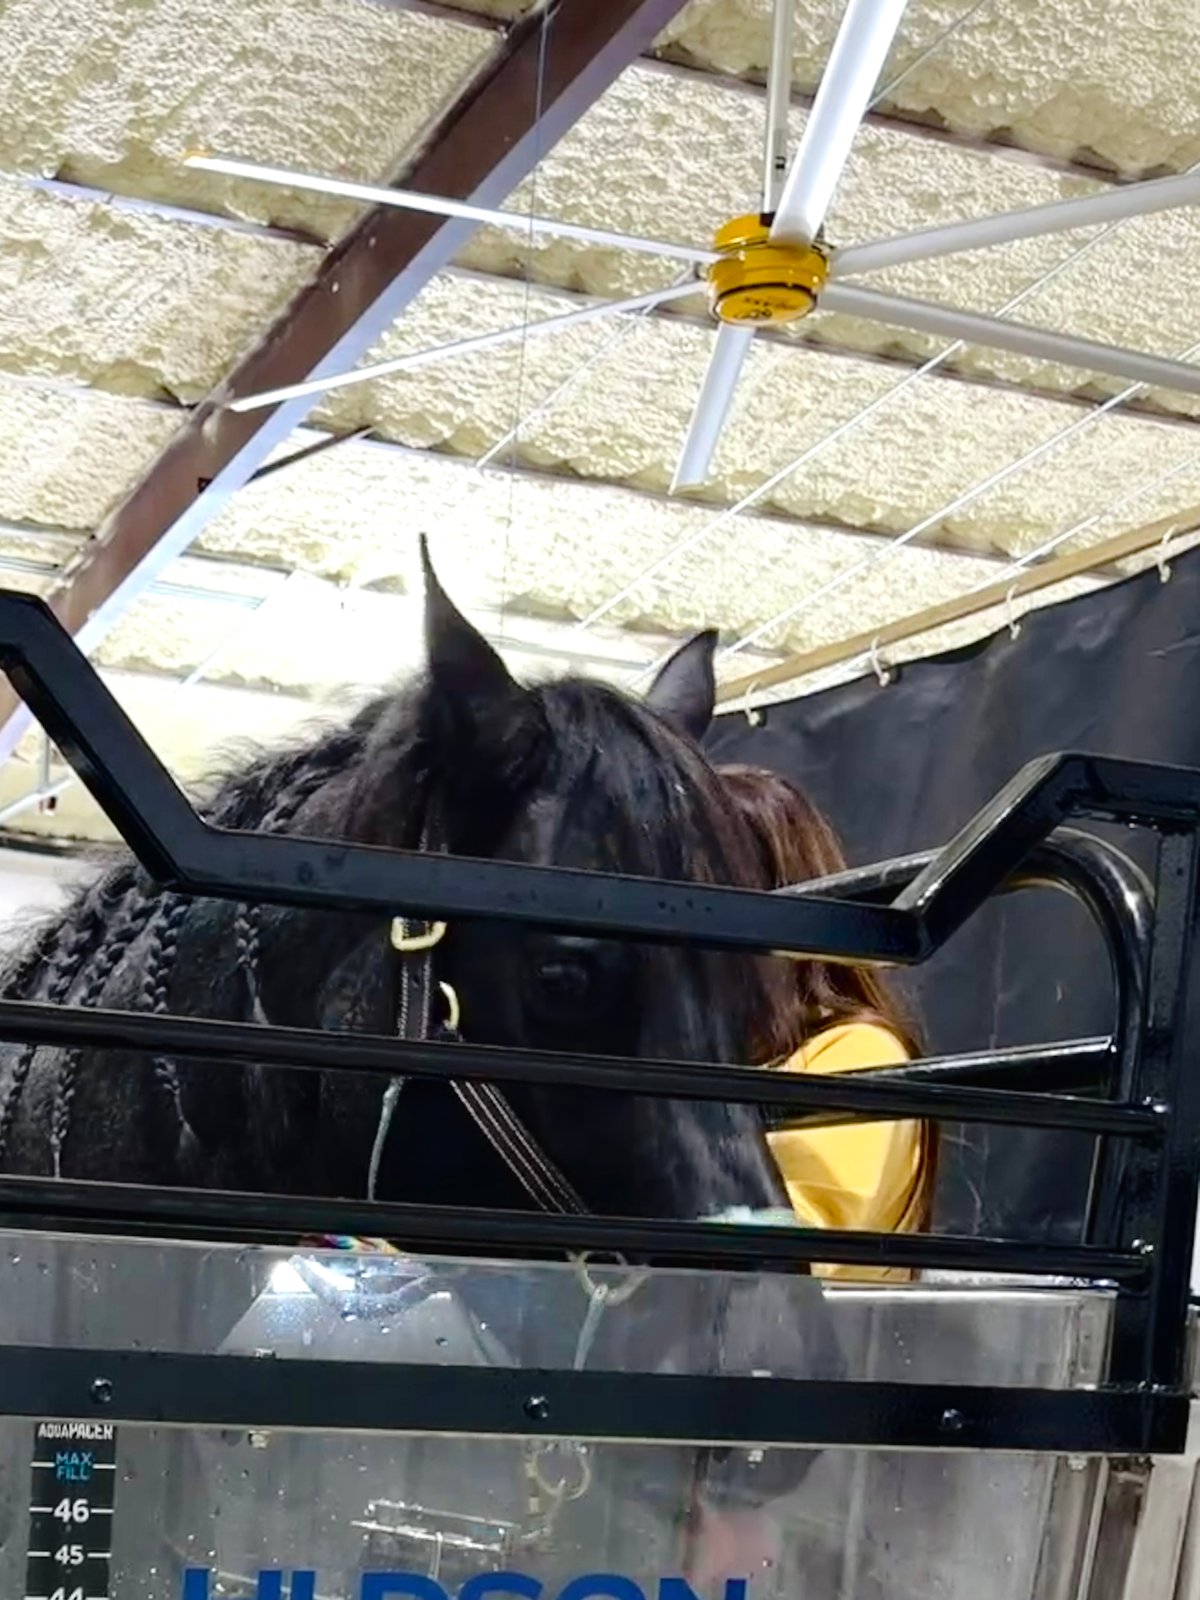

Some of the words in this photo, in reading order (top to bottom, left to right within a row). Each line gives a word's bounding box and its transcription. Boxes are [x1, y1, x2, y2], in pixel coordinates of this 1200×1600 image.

[56, 1452, 92, 1465] MAX
[56, 1465, 90, 1480] FILL
[53, 1498, 91, 1524] 46
[54, 1543, 85, 1567] 45
